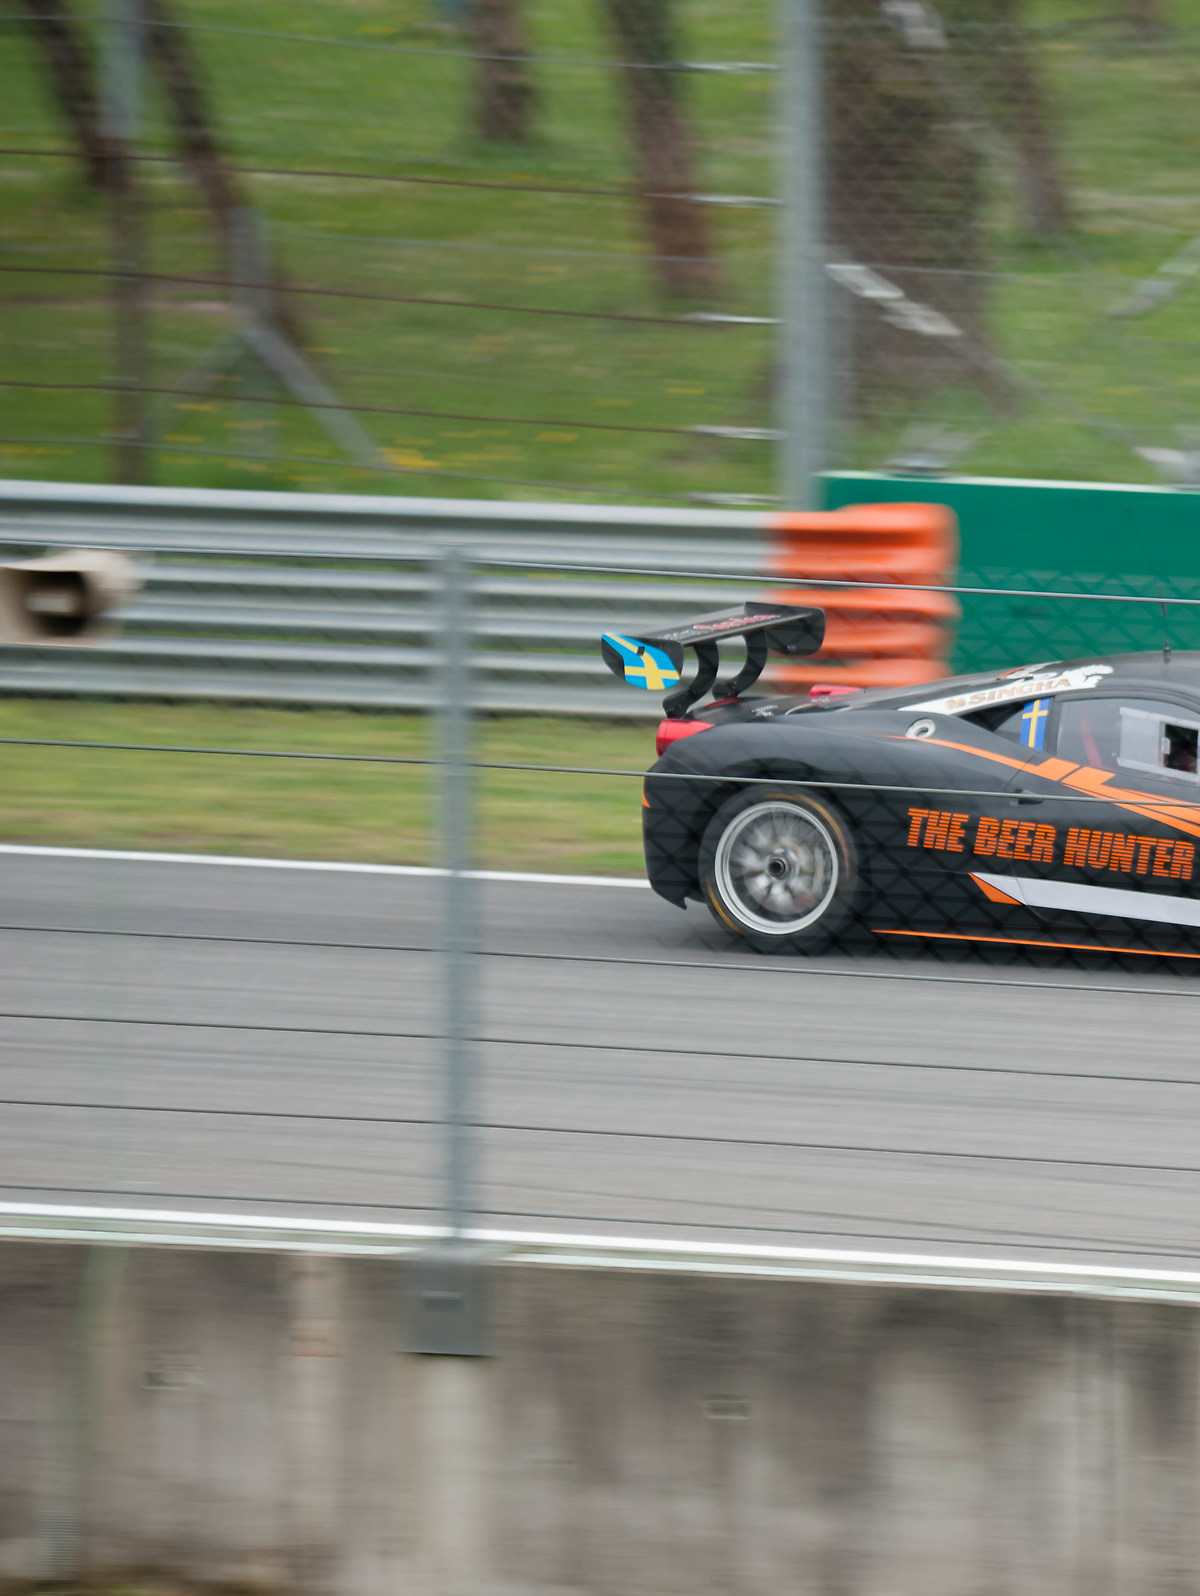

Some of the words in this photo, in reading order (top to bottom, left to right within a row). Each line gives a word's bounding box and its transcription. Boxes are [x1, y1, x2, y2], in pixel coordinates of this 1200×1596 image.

[969, 678, 1072, 703] SINGHA
[907, 808, 969, 852] THE
[973, 816, 1056, 863] BEER
[1063, 827, 1195, 880] HUNTER
